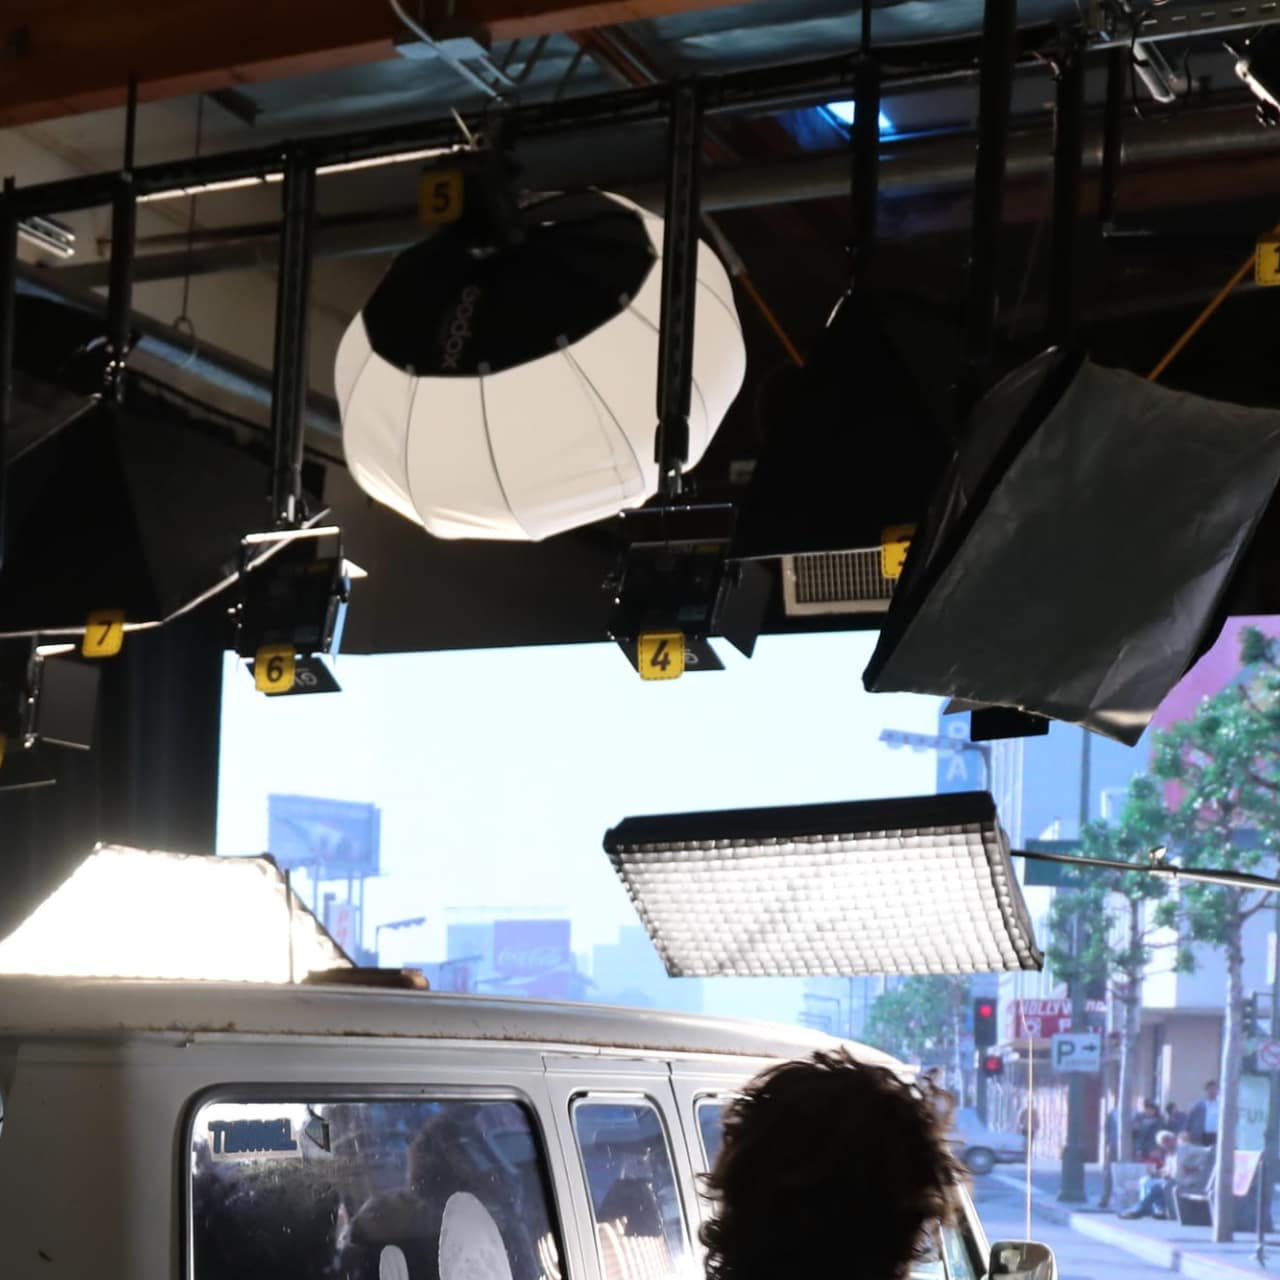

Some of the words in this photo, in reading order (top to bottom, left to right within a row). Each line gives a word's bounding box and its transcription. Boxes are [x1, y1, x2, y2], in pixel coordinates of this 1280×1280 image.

[433, 181, 452, 214] 5
[97, 620, 113, 646] 7
[650, 640, 671, 671] 4
[266, 656, 283, 683] 6
[1056, 1040, 1076, 1065] P
